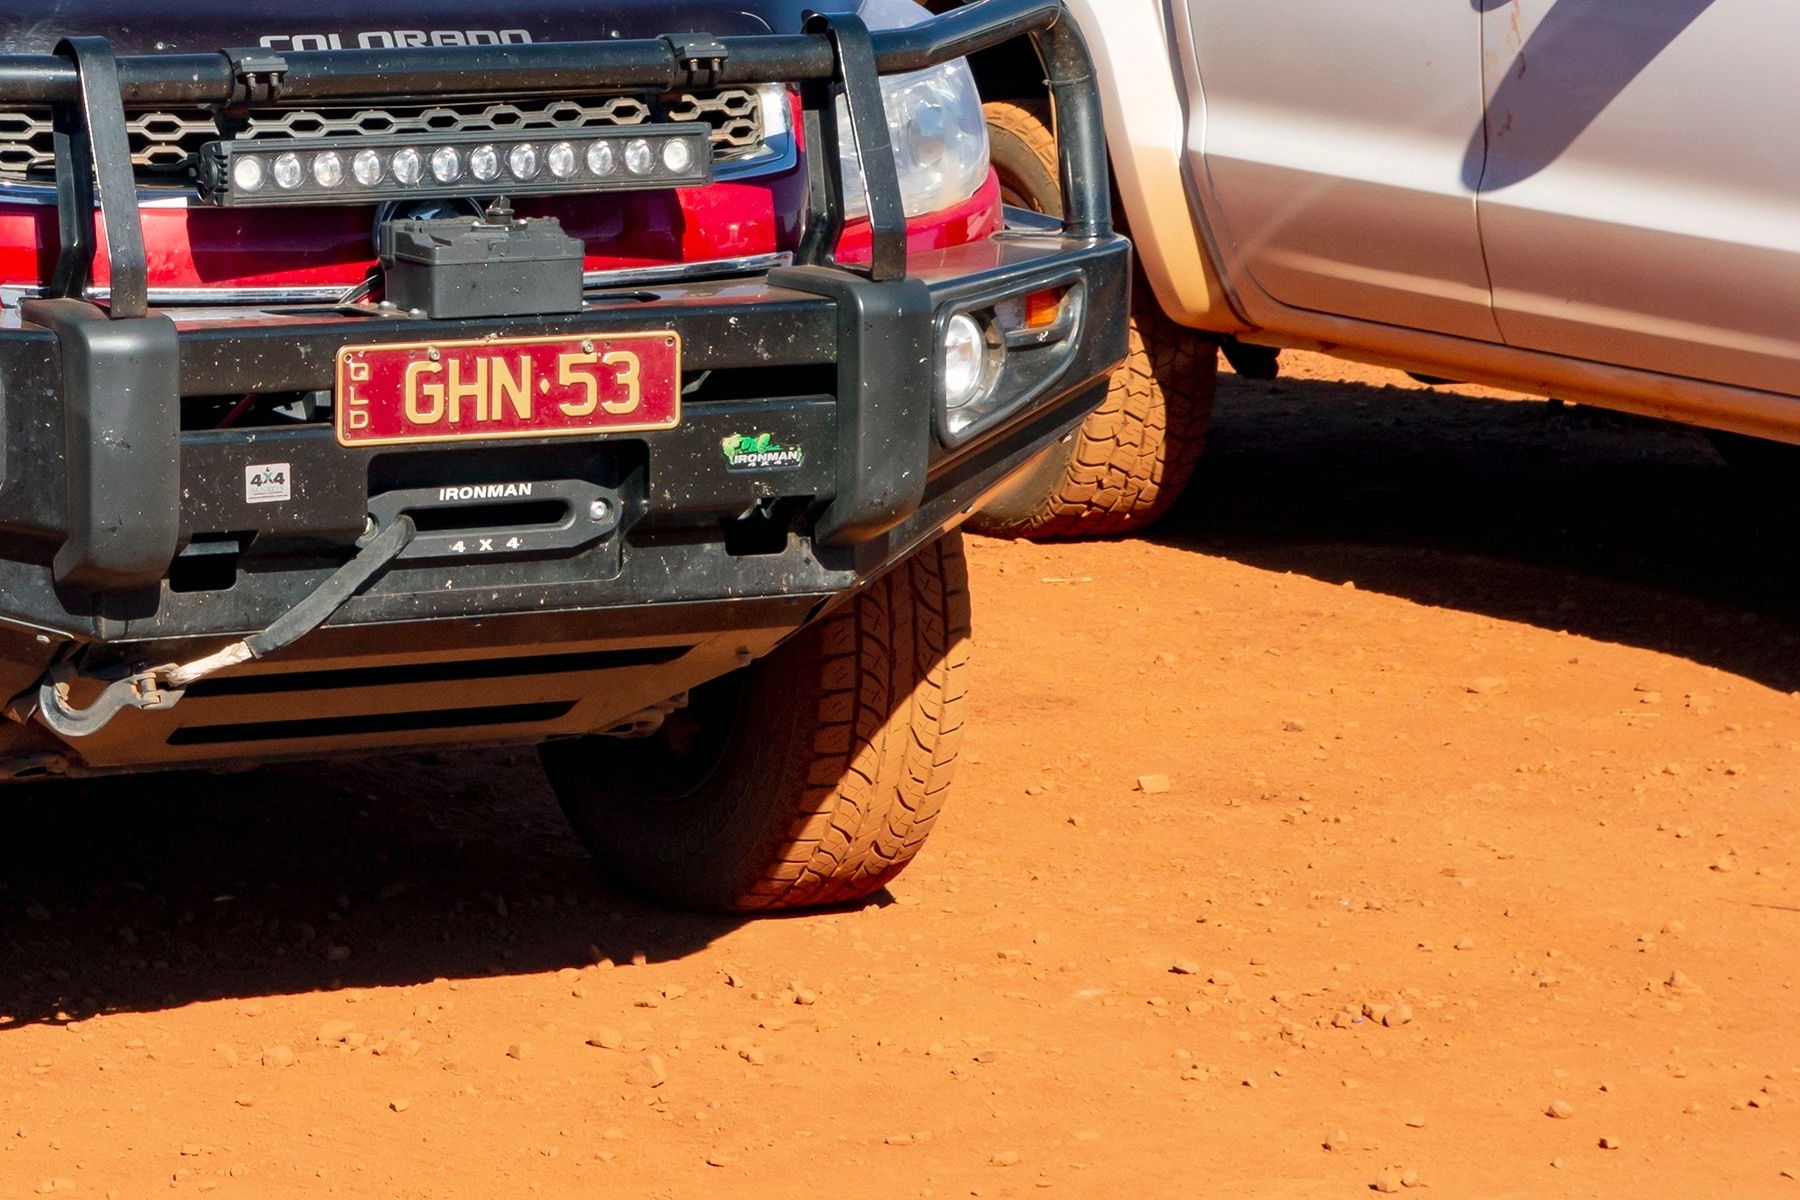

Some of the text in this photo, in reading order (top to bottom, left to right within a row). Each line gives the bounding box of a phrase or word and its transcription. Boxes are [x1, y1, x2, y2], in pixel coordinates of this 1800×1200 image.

[350, 362, 369, 429] QLD
[734, 451, 798, 464] IRONMAN
[439, 483, 532, 501] IRONMAN
